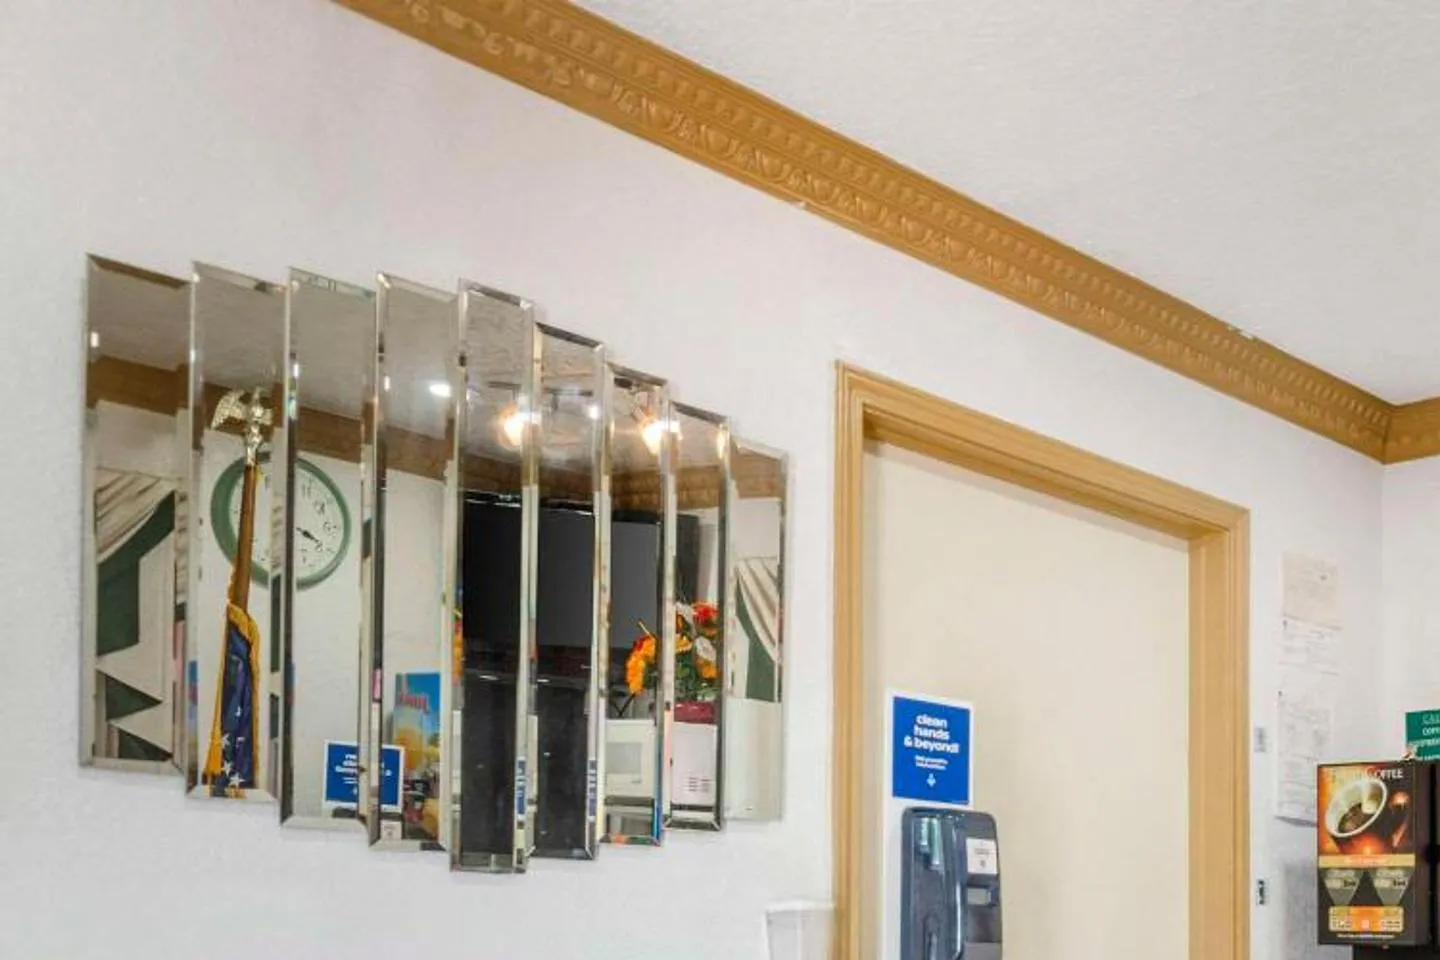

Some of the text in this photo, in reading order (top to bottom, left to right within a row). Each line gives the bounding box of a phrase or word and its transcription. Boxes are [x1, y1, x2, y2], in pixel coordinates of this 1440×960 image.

[915, 713, 948, 729] clean
[913, 724, 951, 741] hands
[903, 735, 913, 747] &
